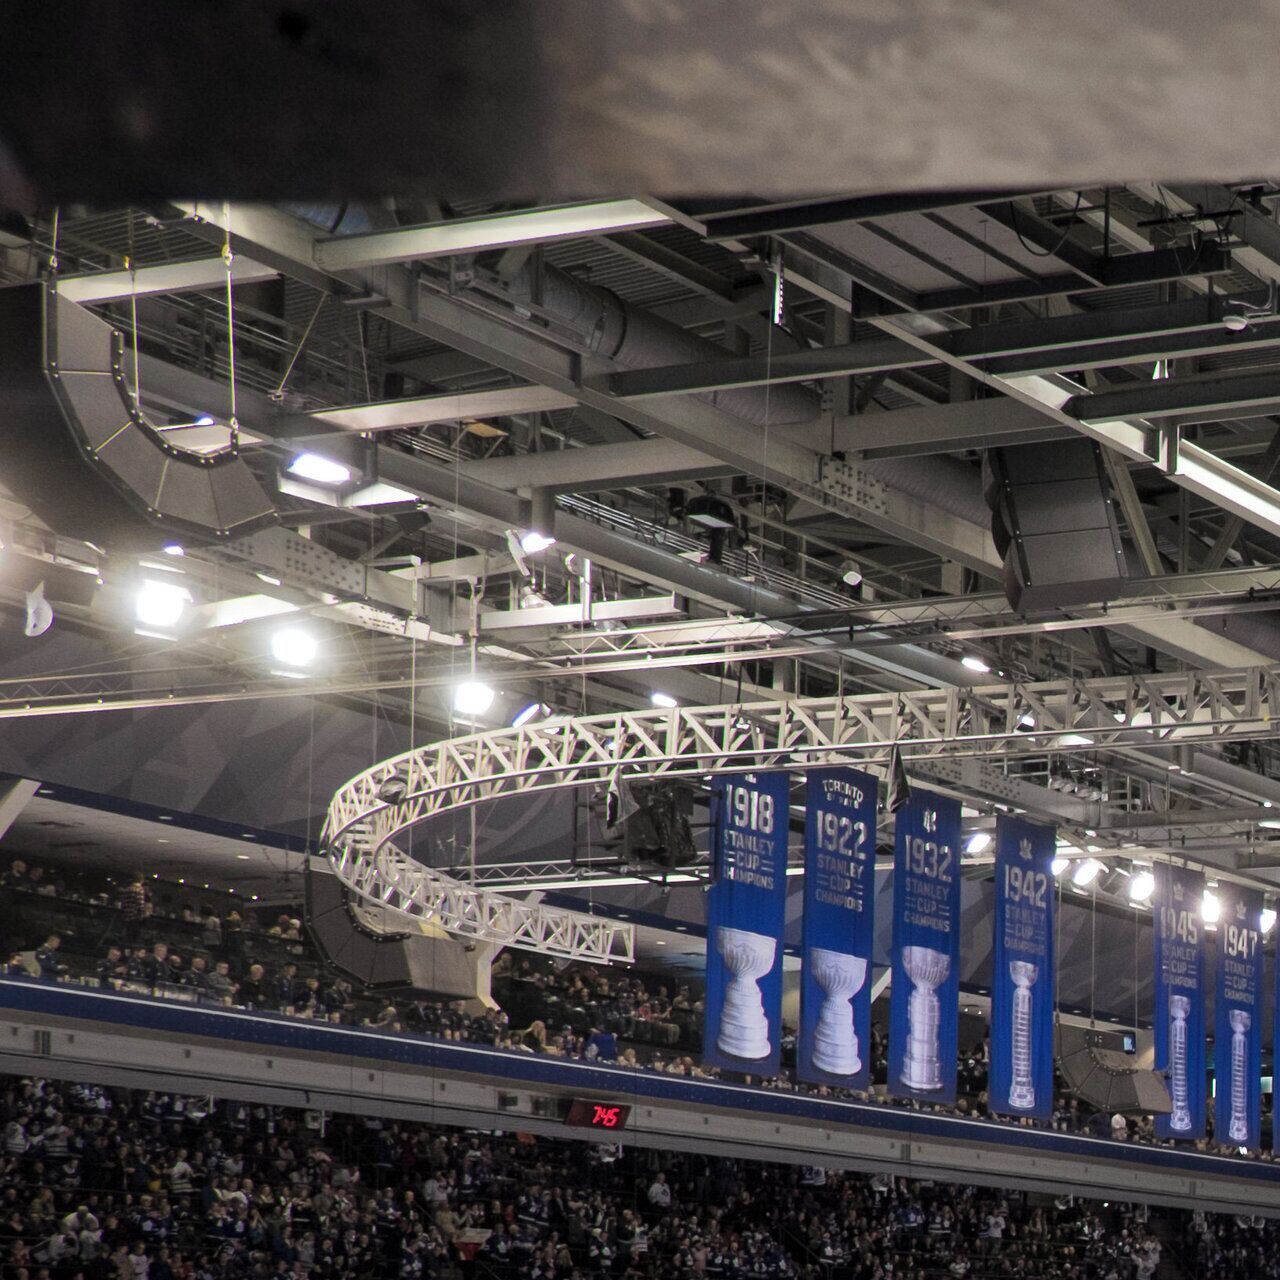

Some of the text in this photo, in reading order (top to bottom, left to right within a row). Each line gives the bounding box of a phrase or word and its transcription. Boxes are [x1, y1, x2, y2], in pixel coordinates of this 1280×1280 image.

[822, 779, 864, 802] TORONTO
[726, 784, 774, 834] 1918
[724, 829, 774, 856] STANLEY
[816, 810, 867, 860] 1922
[736, 851, 760, 870] CUP
[816, 854, 864, 880] STANLEY
[905, 835, 952, 883] 1932
[830, 875, 851, 893] CUP
[905, 878, 949, 901] STANLEY
[1004, 864, 1047, 909] 1942
[815, 888, 863, 912] CHAMPIONS
[917, 898, 937, 914] CUP
[904, 910, 950, 932] CHAMPIONS
[1005, 904, 1046, 925] STANLEY
[1160, 907, 1198, 945] 1945
[1014, 923, 1034, 937] CUP
[1223, 923, 1258, 960] 1947
[1171, 960, 1187, 974] CUP
[1232, 978, 1248, 991] CUP
